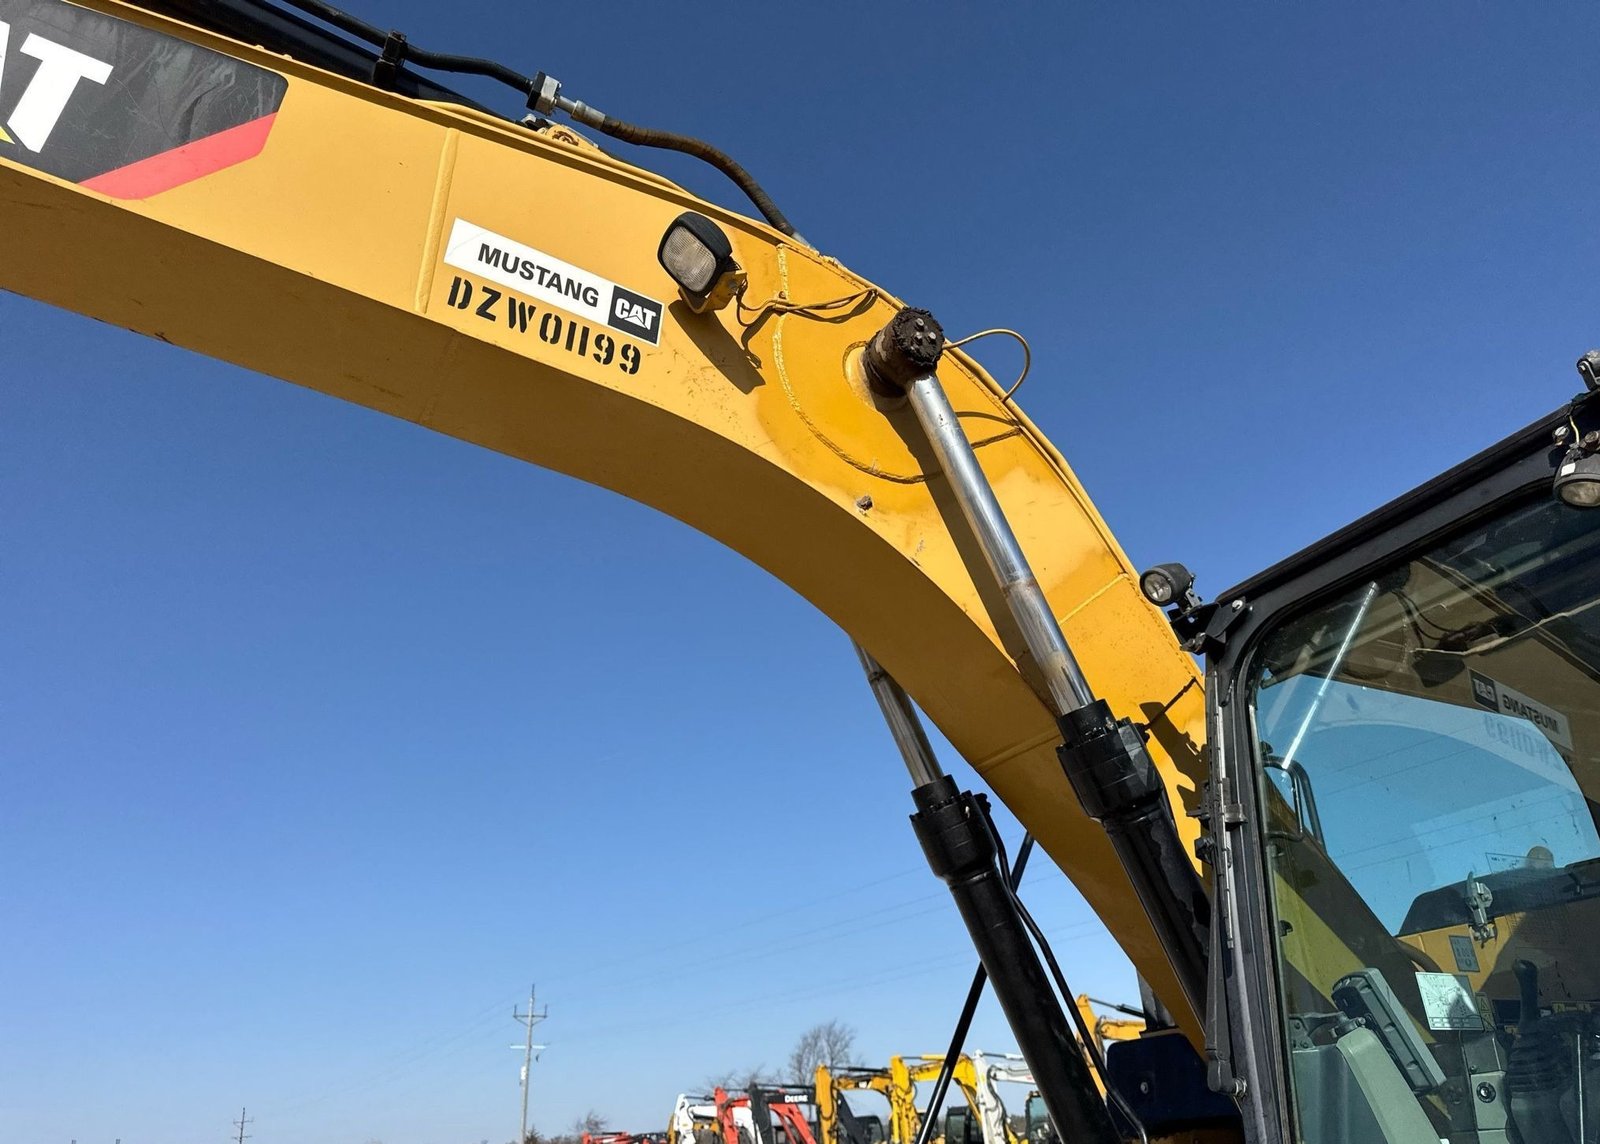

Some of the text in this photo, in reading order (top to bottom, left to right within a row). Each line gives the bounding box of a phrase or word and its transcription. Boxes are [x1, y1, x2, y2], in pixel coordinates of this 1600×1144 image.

[447, 275, 641, 375] DZW01199
[478, 243, 657, 330] MUSTANG CAT
